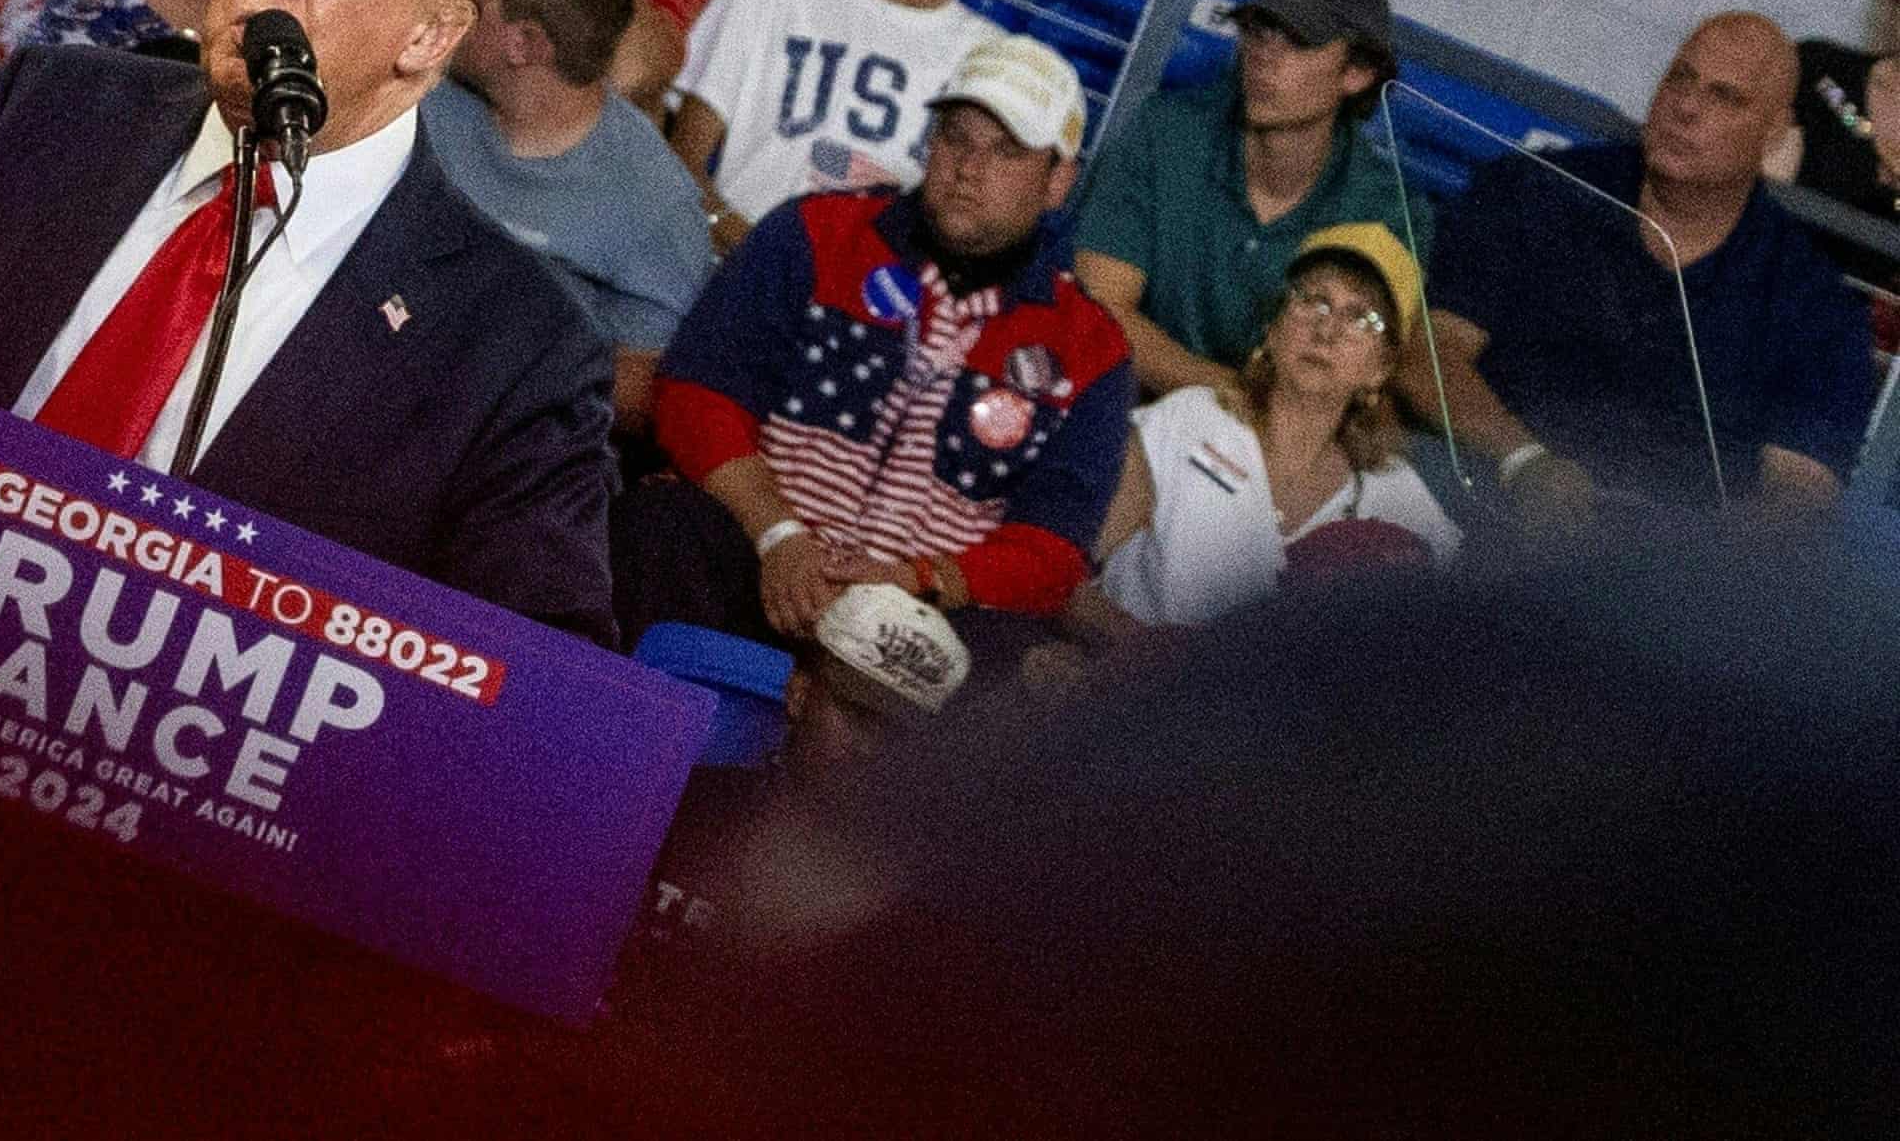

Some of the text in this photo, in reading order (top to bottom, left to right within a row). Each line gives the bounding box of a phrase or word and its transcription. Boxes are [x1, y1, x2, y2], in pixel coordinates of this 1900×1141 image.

[775, 33, 933, 167] US
[247, 568, 313, 625] TO
[322, 604, 489, 701] 88022
[95, 759, 190, 809] GREAT
[195, 798, 299, 852] AGAIN!
